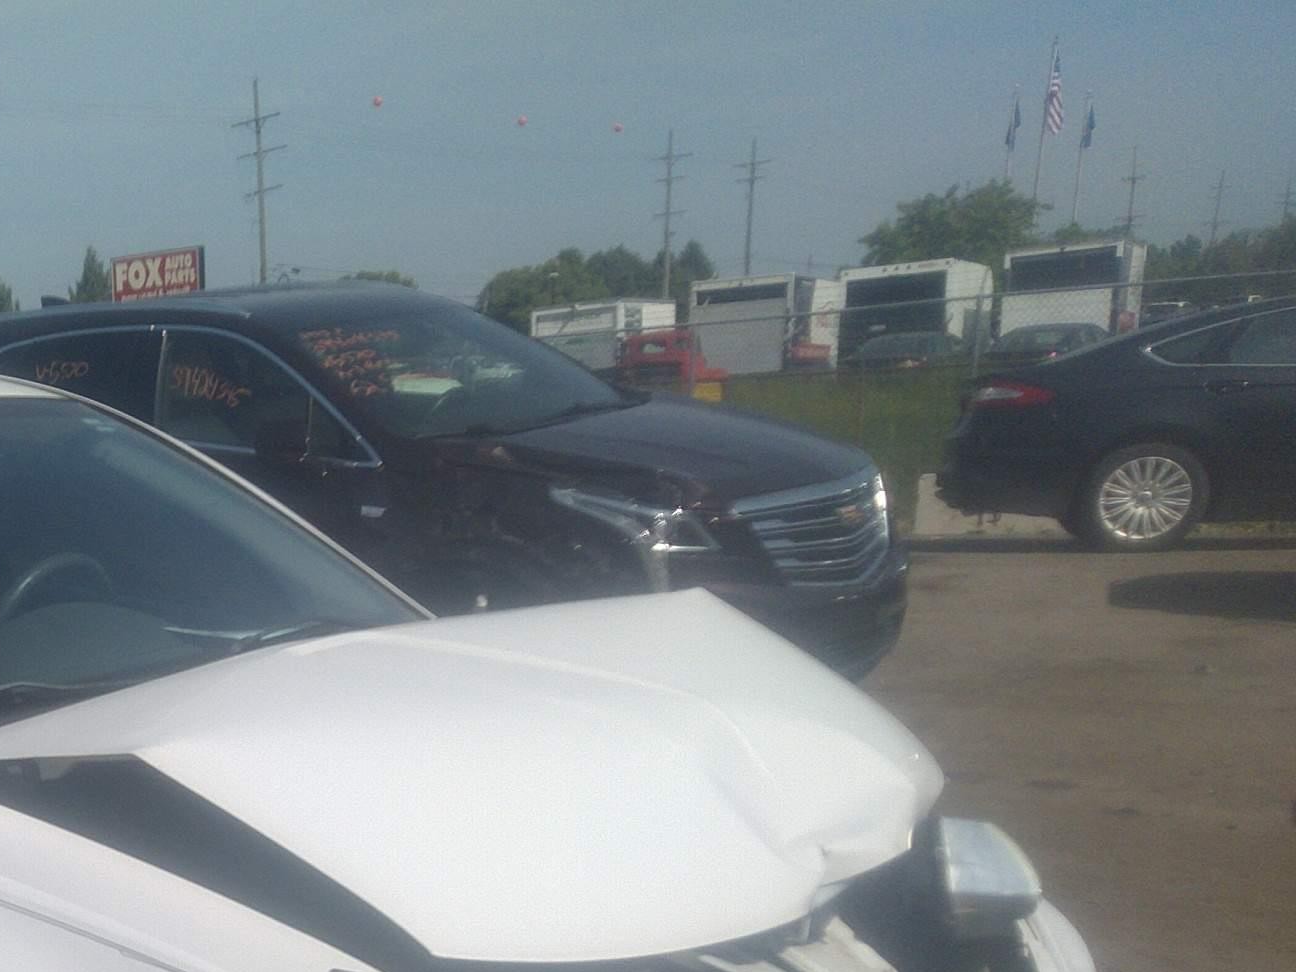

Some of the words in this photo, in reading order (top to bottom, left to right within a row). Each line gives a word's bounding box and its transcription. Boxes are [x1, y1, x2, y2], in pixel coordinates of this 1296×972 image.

[165, 253, 193, 270] AUTO
[115, 257, 163, 292] FOX
[165, 267, 196, 286] PARTS
